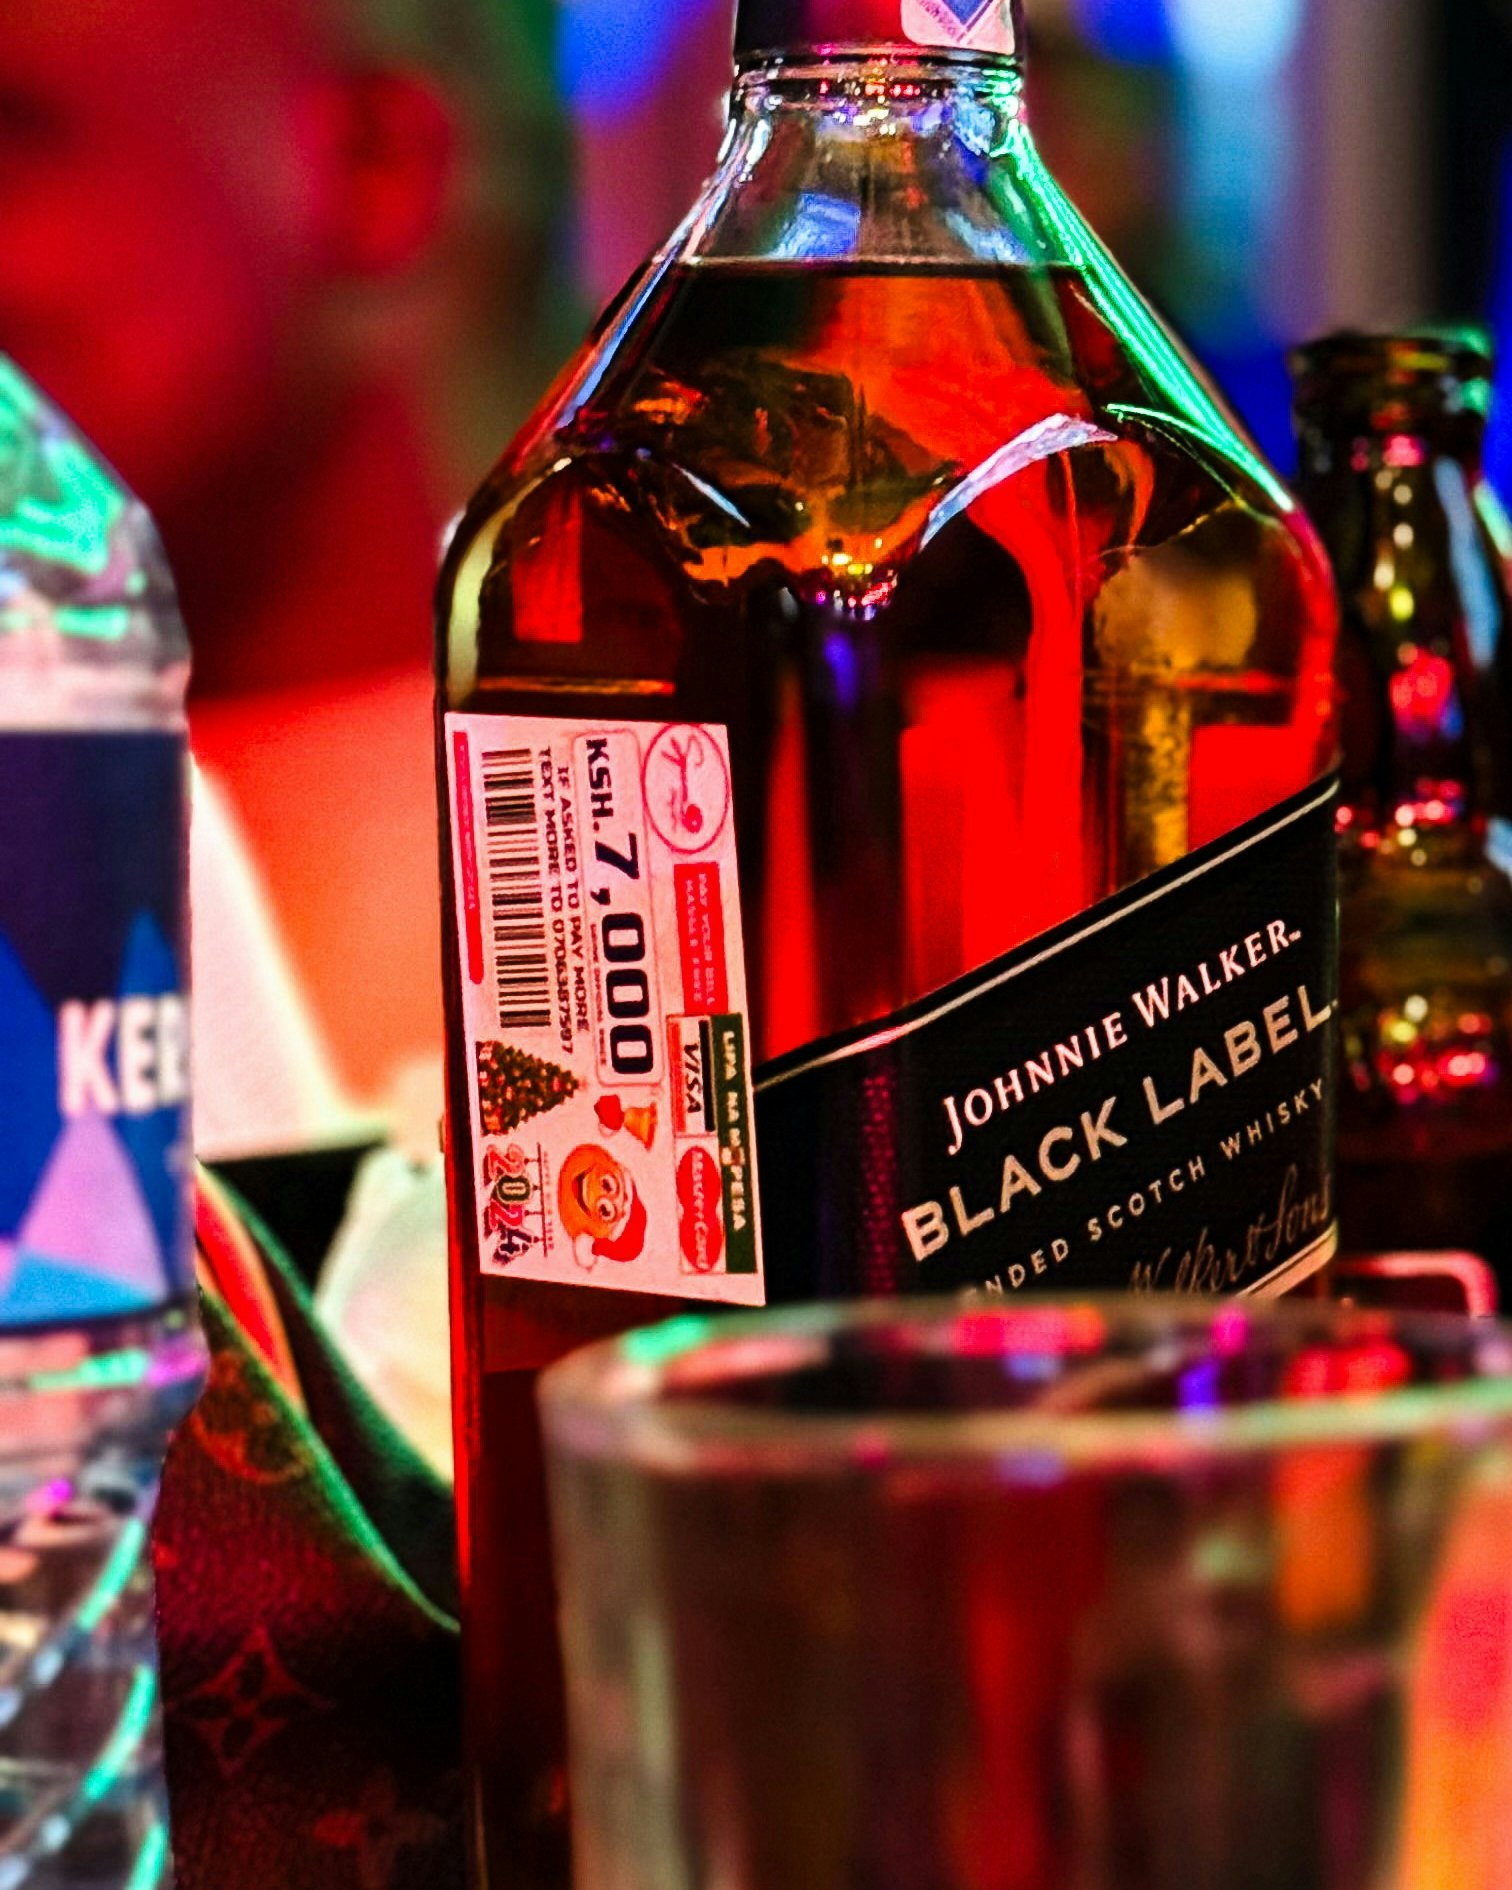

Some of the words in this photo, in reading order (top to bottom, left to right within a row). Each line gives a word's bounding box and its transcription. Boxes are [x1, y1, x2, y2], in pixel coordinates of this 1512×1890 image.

[538, 745, 554, 801] TEXT
[557, 767, 570, 789] IF
[585, 738, 614, 832] KSH.
[544, 809, 560, 876] MORE
[560, 797, 577, 872] ASKED
[551, 885, 563, 912] TO
[567, 880, 580, 909] TO
[569, 915, 584, 959] PAY
[590, 832, 654, 1075] 7,000
[573, 966, 590, 1032] MORE
[684, 1042, 703, 1114] VISA
[722, 1031, 737, 1081] LIPA
[942, 1011, 1128, 1155] JOHNNIE
[901, 1096, 1127, 1262] BLACK
[1142, 984, 1332, 1125] LABEL
[484, 1143, 534, 1266] 2024
[984, 1238, 1070, 1296] NDED
[1087, 1155, 1206, 1241] SCOTCH
[1219, 1079, 1324, 1160] WHISKY
